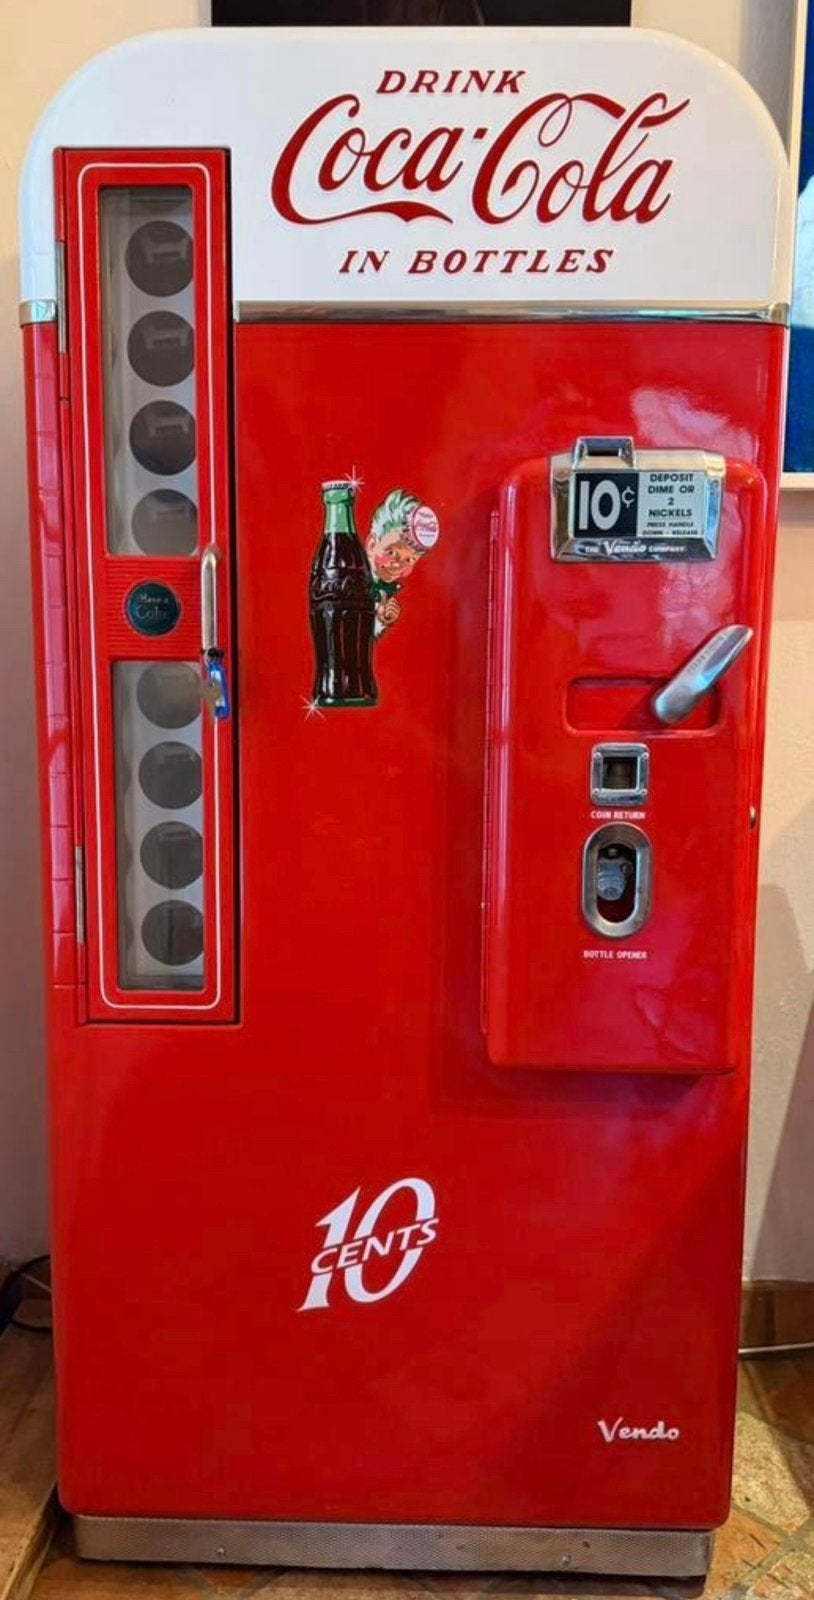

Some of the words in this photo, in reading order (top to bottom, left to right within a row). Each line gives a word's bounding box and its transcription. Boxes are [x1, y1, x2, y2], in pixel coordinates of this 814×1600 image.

[376, 70, 526, 94] DRINK
[271, 92, 691, 226] Coca-Cola
[339, 250, 390, 274] IN
[408, 249, 614, 274] BOTTLES
[650, 473, 694, 482] DEPOSIT
[648, 486, 674, 494] DIME
[679, 485, 695, 494] OR
[667, 496, 675, 506] 2
[648, 509, 693, 518] NICKELS
[603, 539, 647, 556] Vendo
[590, 810, 612, 819] COIN
[613, 810, 646, 819] RETURN
[583, 949, 614, 959] BOTTLE
[616, 950, 647, 959] OPENER
[296, 1177, 436, 1313] 10
[310, 1217, 440, 1274] CENTS
[597, 1417, 680, 1443] Vendo
